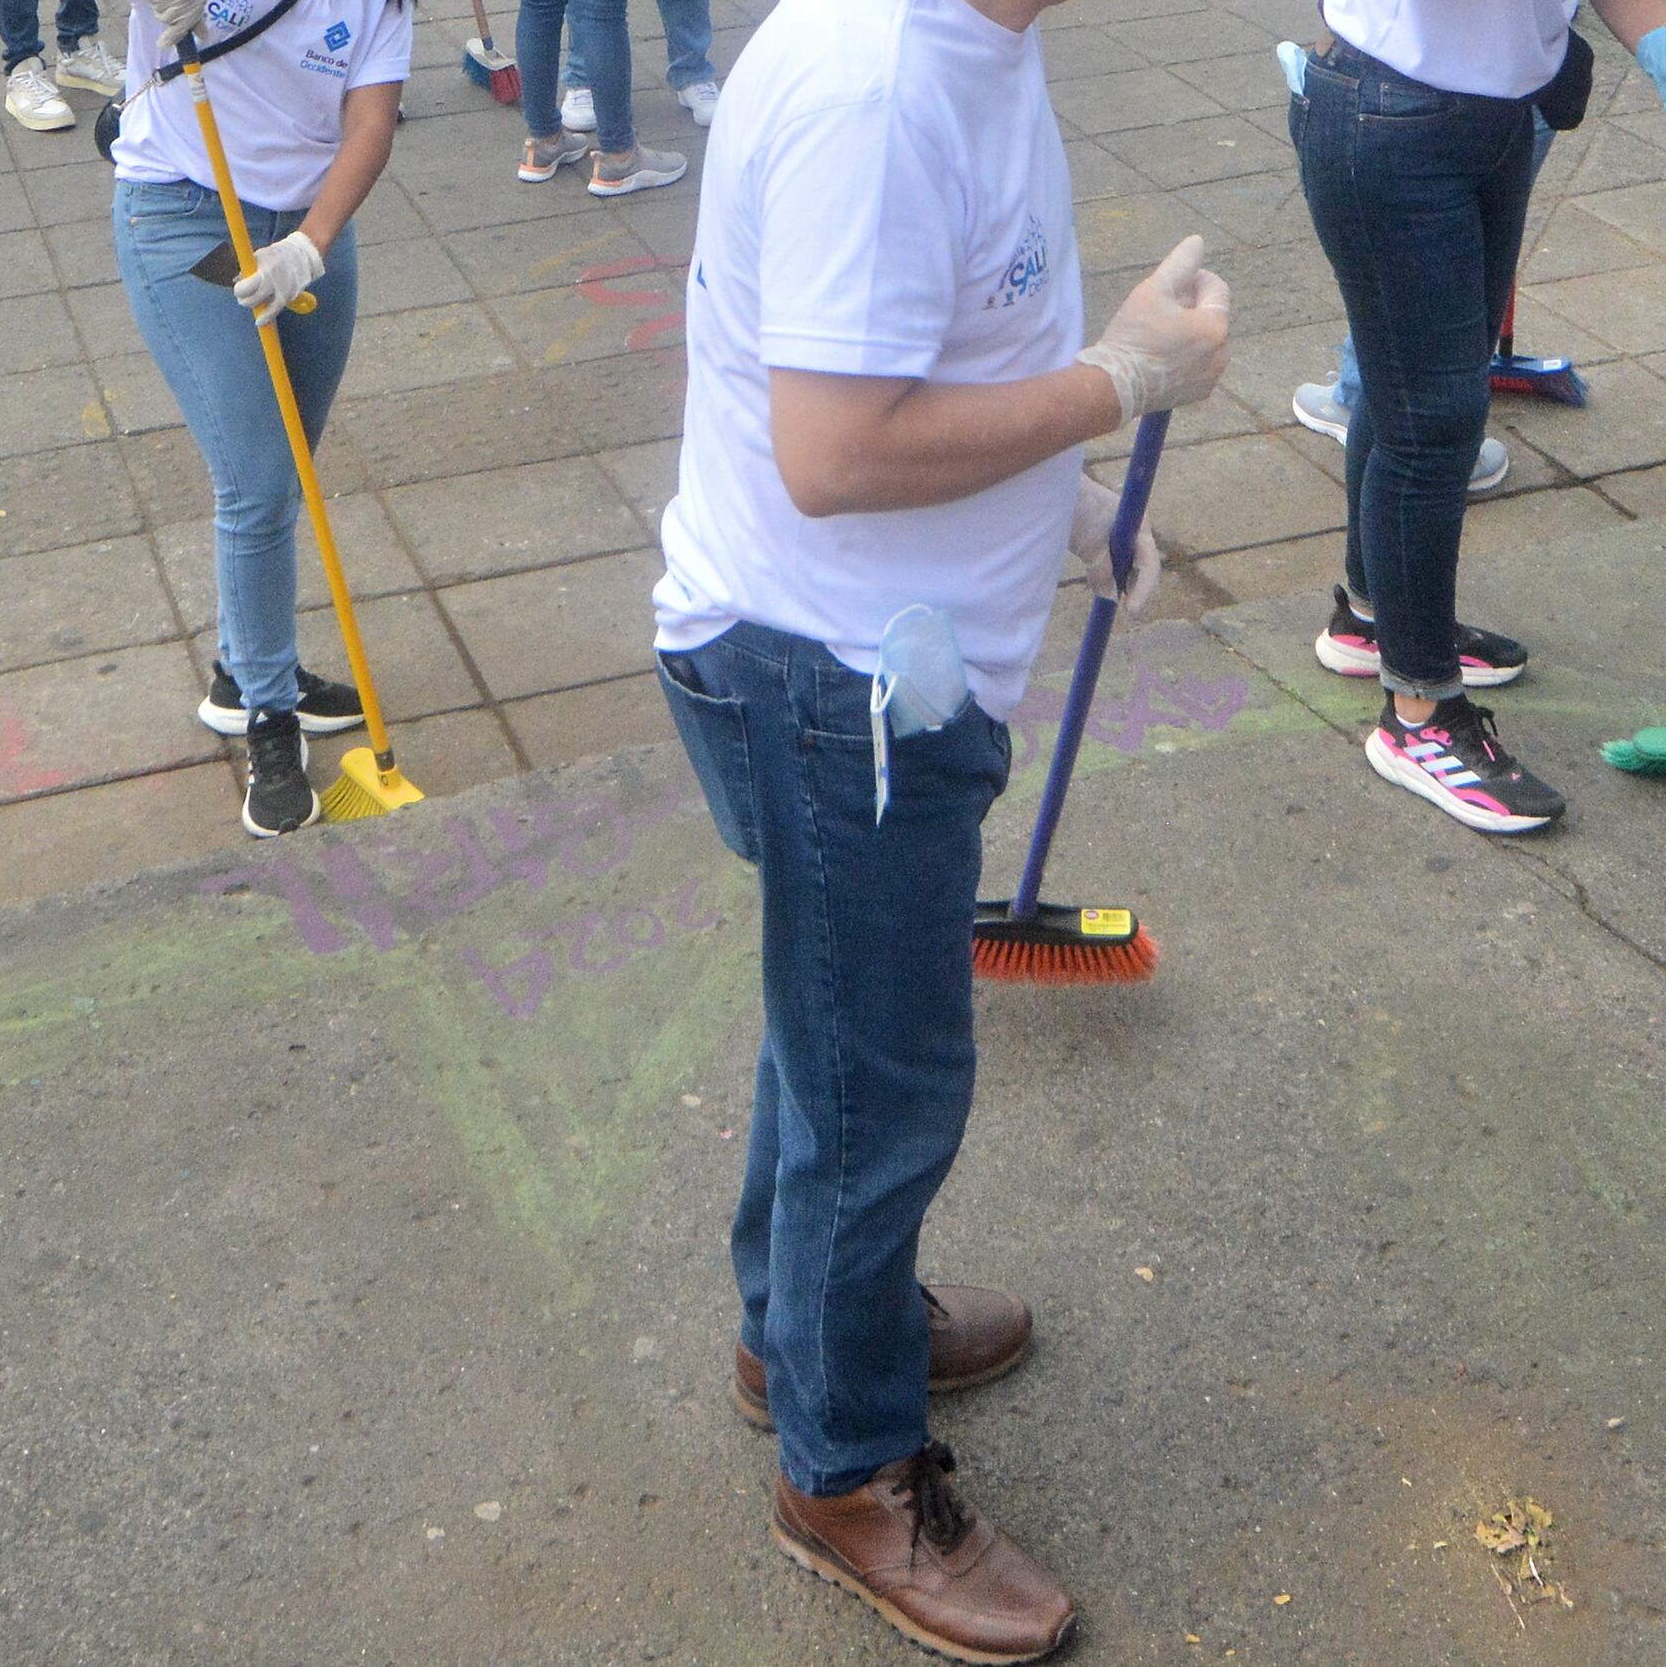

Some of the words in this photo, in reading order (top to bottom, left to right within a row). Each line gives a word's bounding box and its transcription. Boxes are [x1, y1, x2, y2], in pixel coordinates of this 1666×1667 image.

[207, 1, 245, 28] CALI
[299, 59, 347, 80] Occidente
[305, 48, 335, 67] Banco
[335, 58, 348, 69] de
[1009, 246, 1047, 296] CALI
